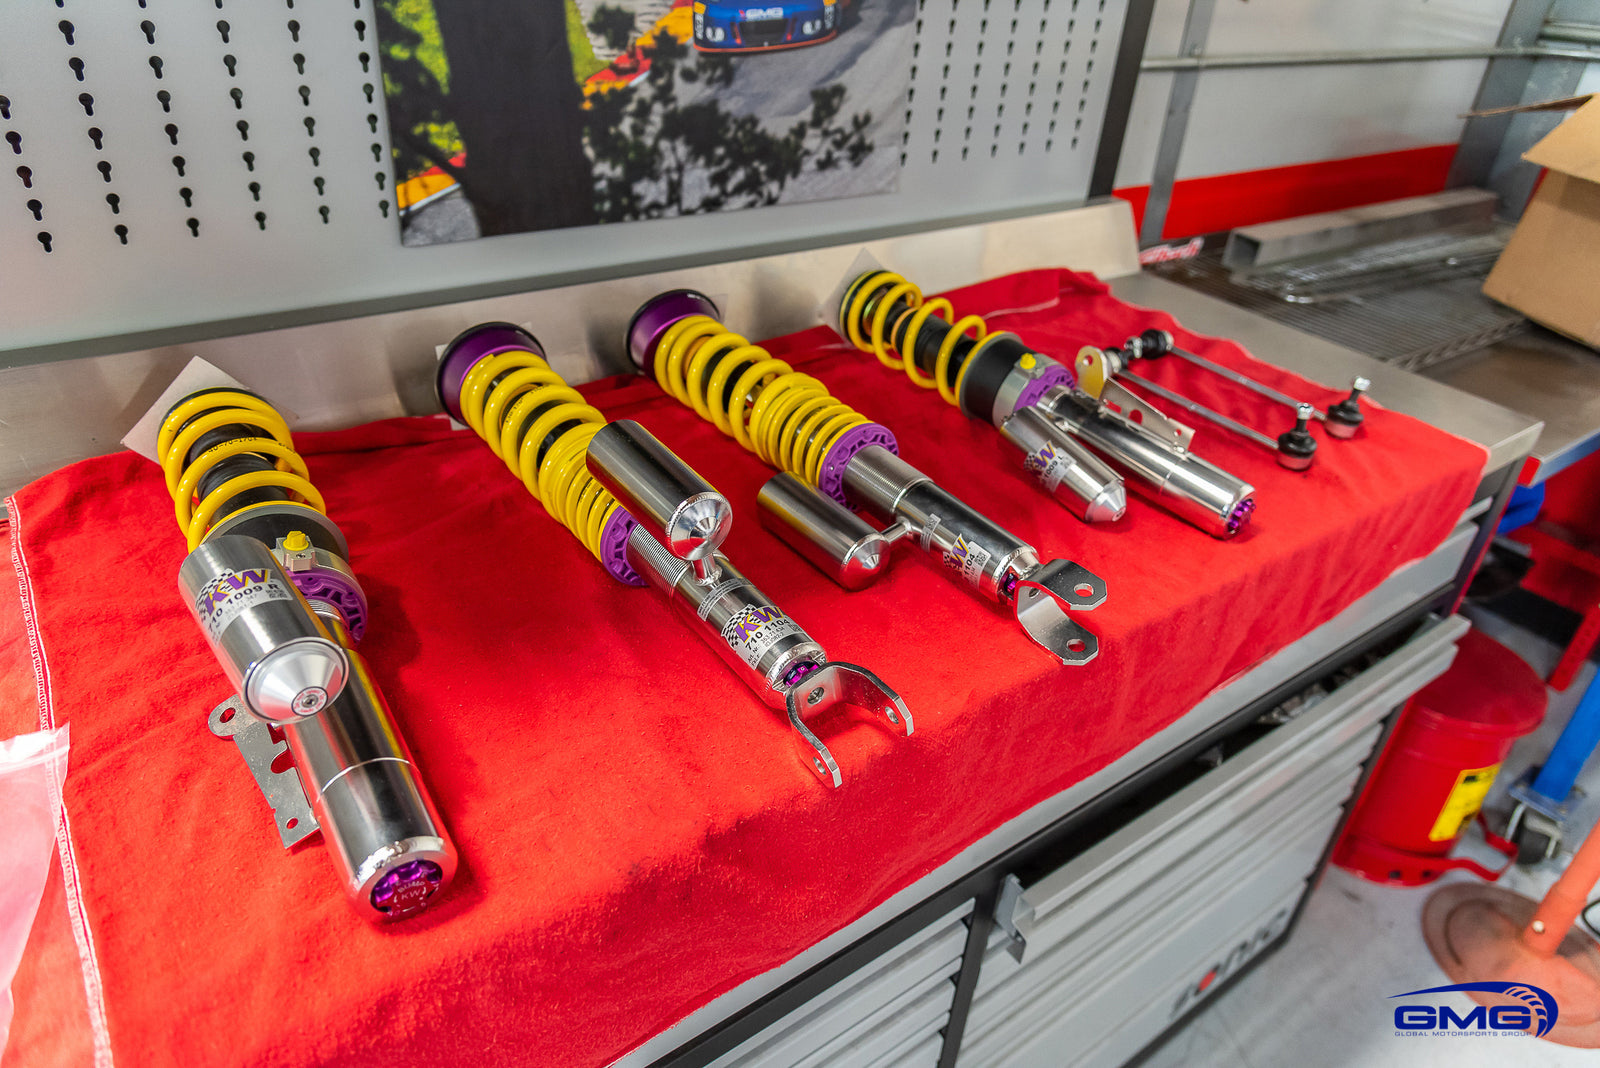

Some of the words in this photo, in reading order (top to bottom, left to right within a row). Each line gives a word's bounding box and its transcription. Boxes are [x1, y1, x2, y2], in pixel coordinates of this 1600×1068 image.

[745, 7, 783, 19] GMG
[963, 554, 976, 575] 1104
[204, 569, 270, 616] KW
[226, 585, 263, 605] 1009
[734, 606, 784, 643] KW
[745, 631, 763, 650] 710
[764, 619, 790, 631] 1104
[401, 889, 421, 900] KW
